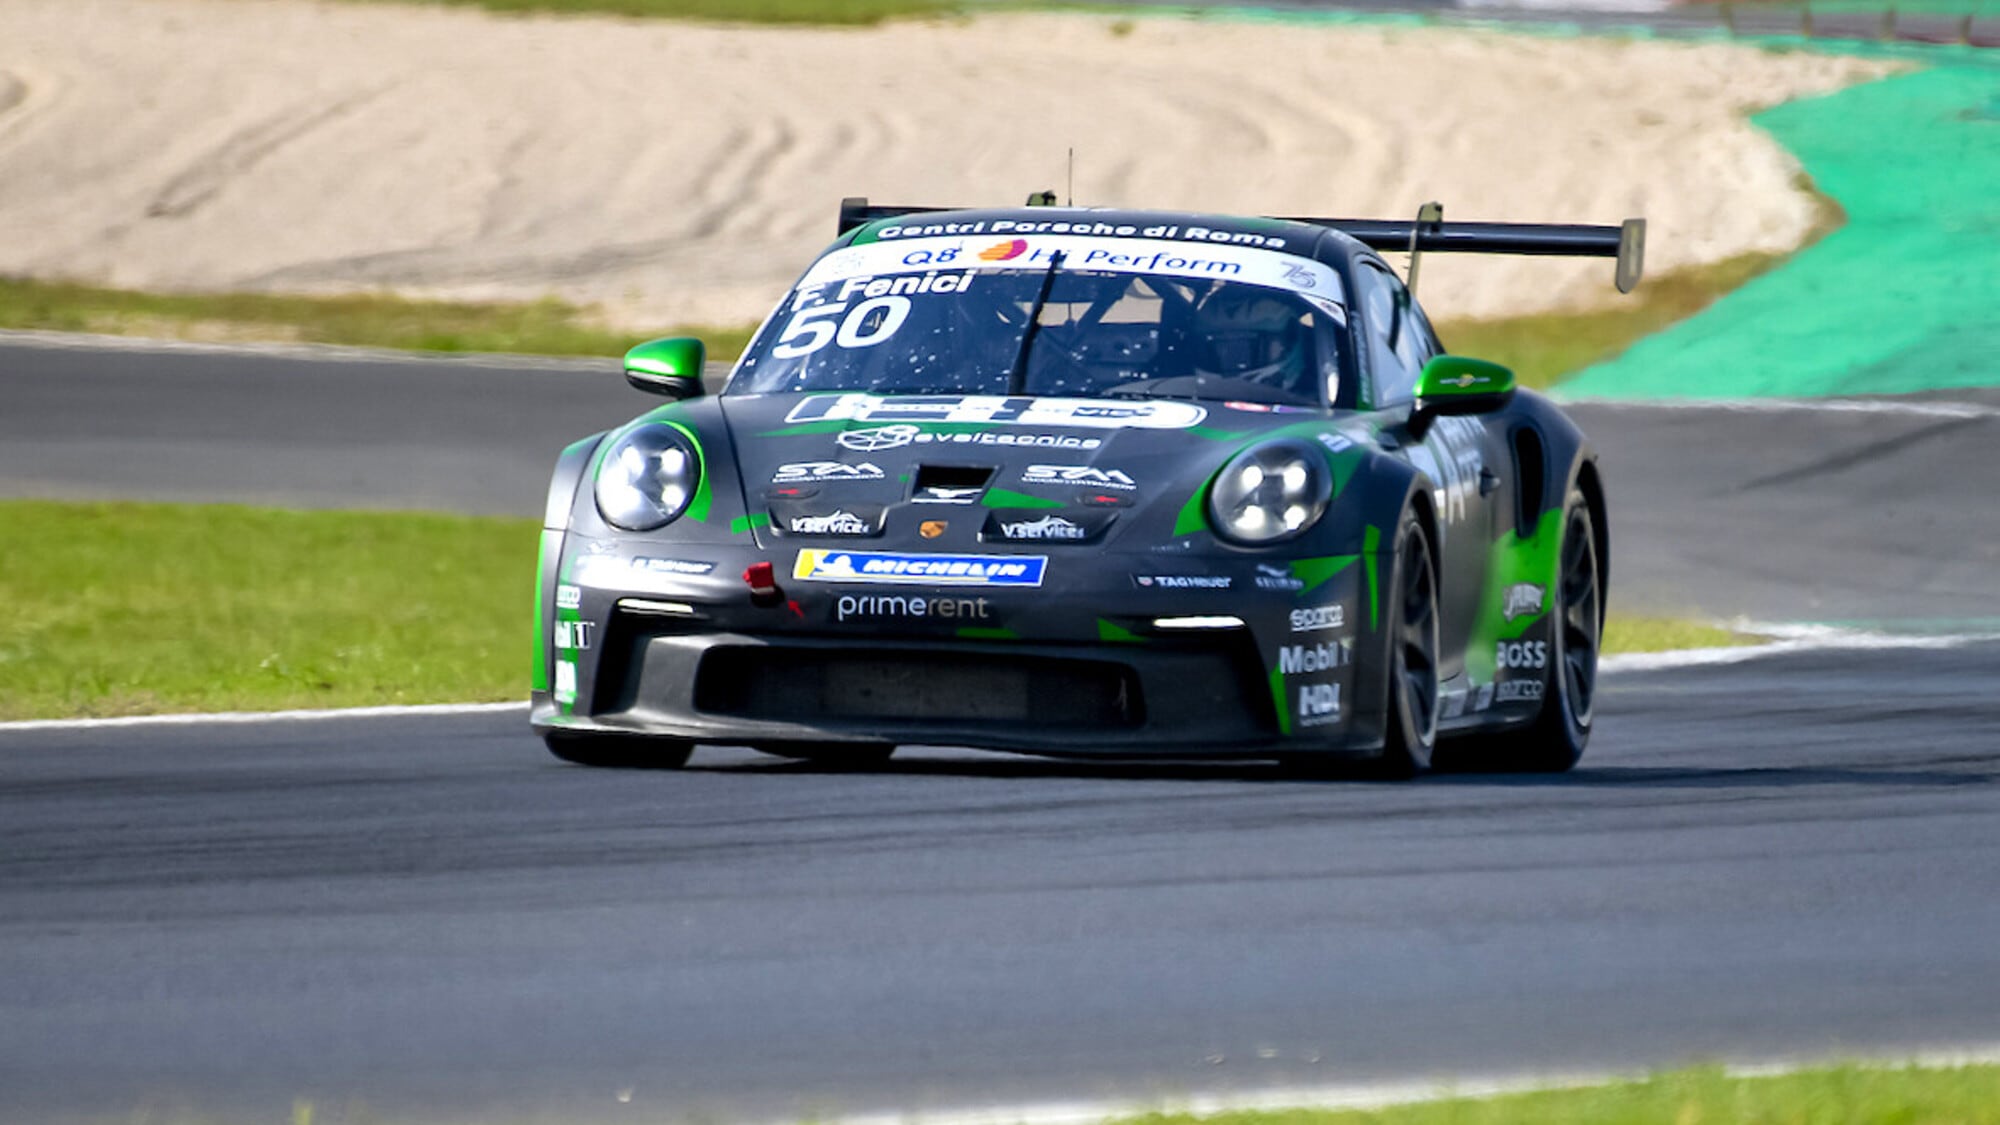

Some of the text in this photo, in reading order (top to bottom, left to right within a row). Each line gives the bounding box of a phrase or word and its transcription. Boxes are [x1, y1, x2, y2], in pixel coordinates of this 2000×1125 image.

[878, 221, 1286, 249] Centri Porsche di Roma
[1084, 249, 1242, 275] Perform
[791, 269, 976, 312] F. Fenici
[772, 296, 912, 360] 50
[863, 559, 1028, 577] MICHELIN
[838, 595, 990, 622] primerent
[1279, 642, 1339, 674] Mobil
[1496, 640, 1546, 670] BOSS
